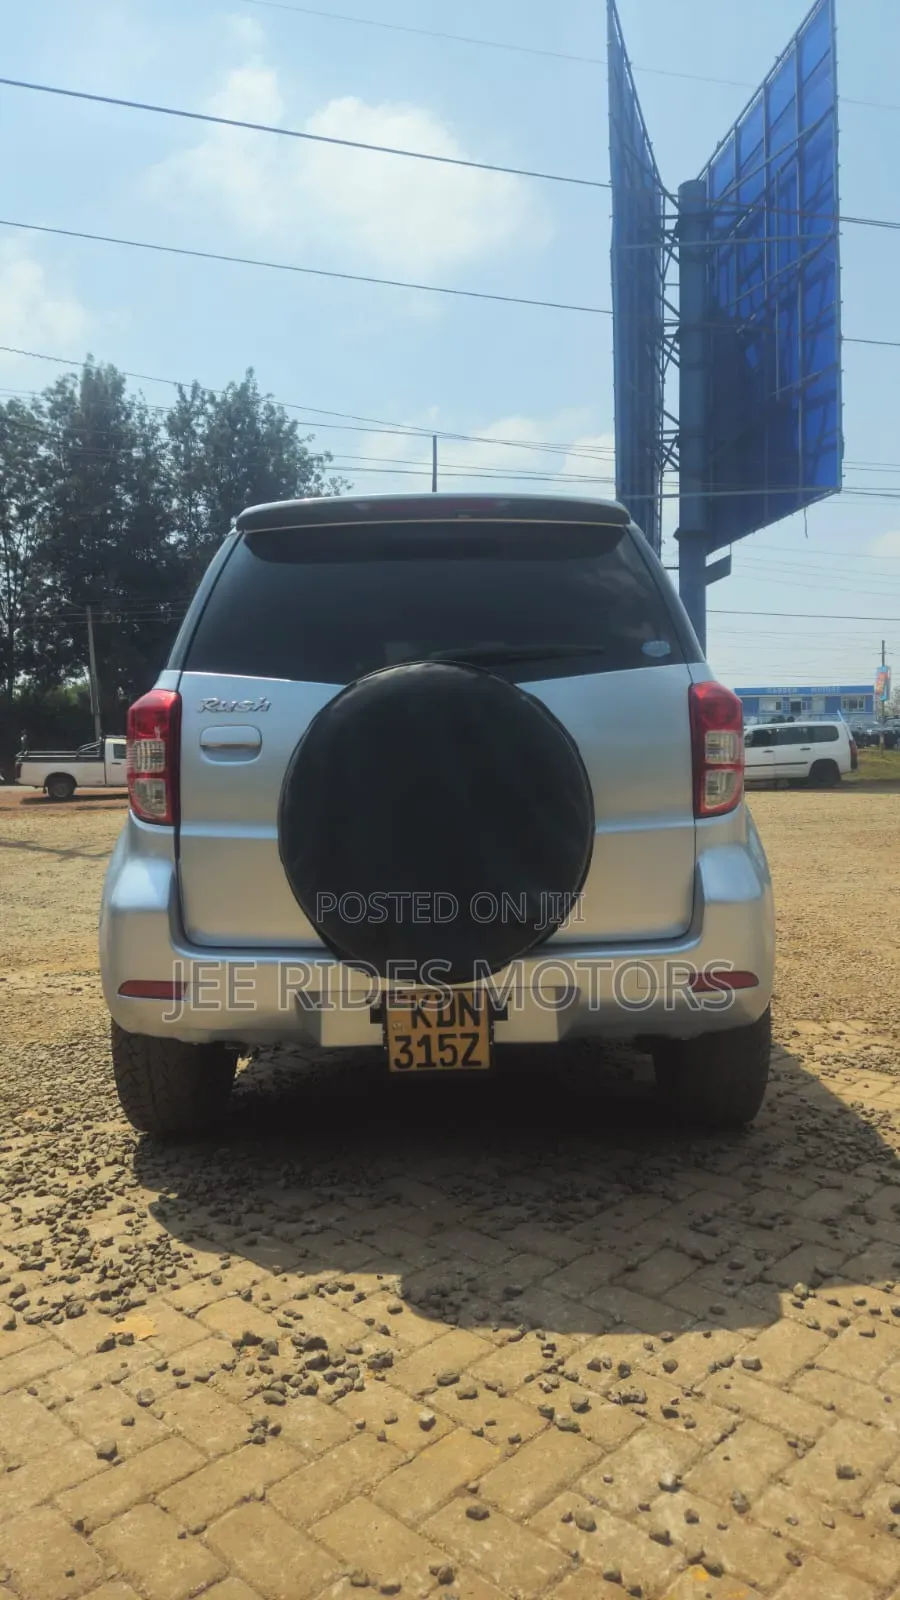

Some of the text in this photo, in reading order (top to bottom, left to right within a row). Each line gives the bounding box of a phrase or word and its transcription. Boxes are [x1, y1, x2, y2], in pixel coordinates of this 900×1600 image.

[198, 696, 272, 714] Rush
[410, 992, 481, 1029] KDN
[393, 1032, 482, 1070] 315Z
